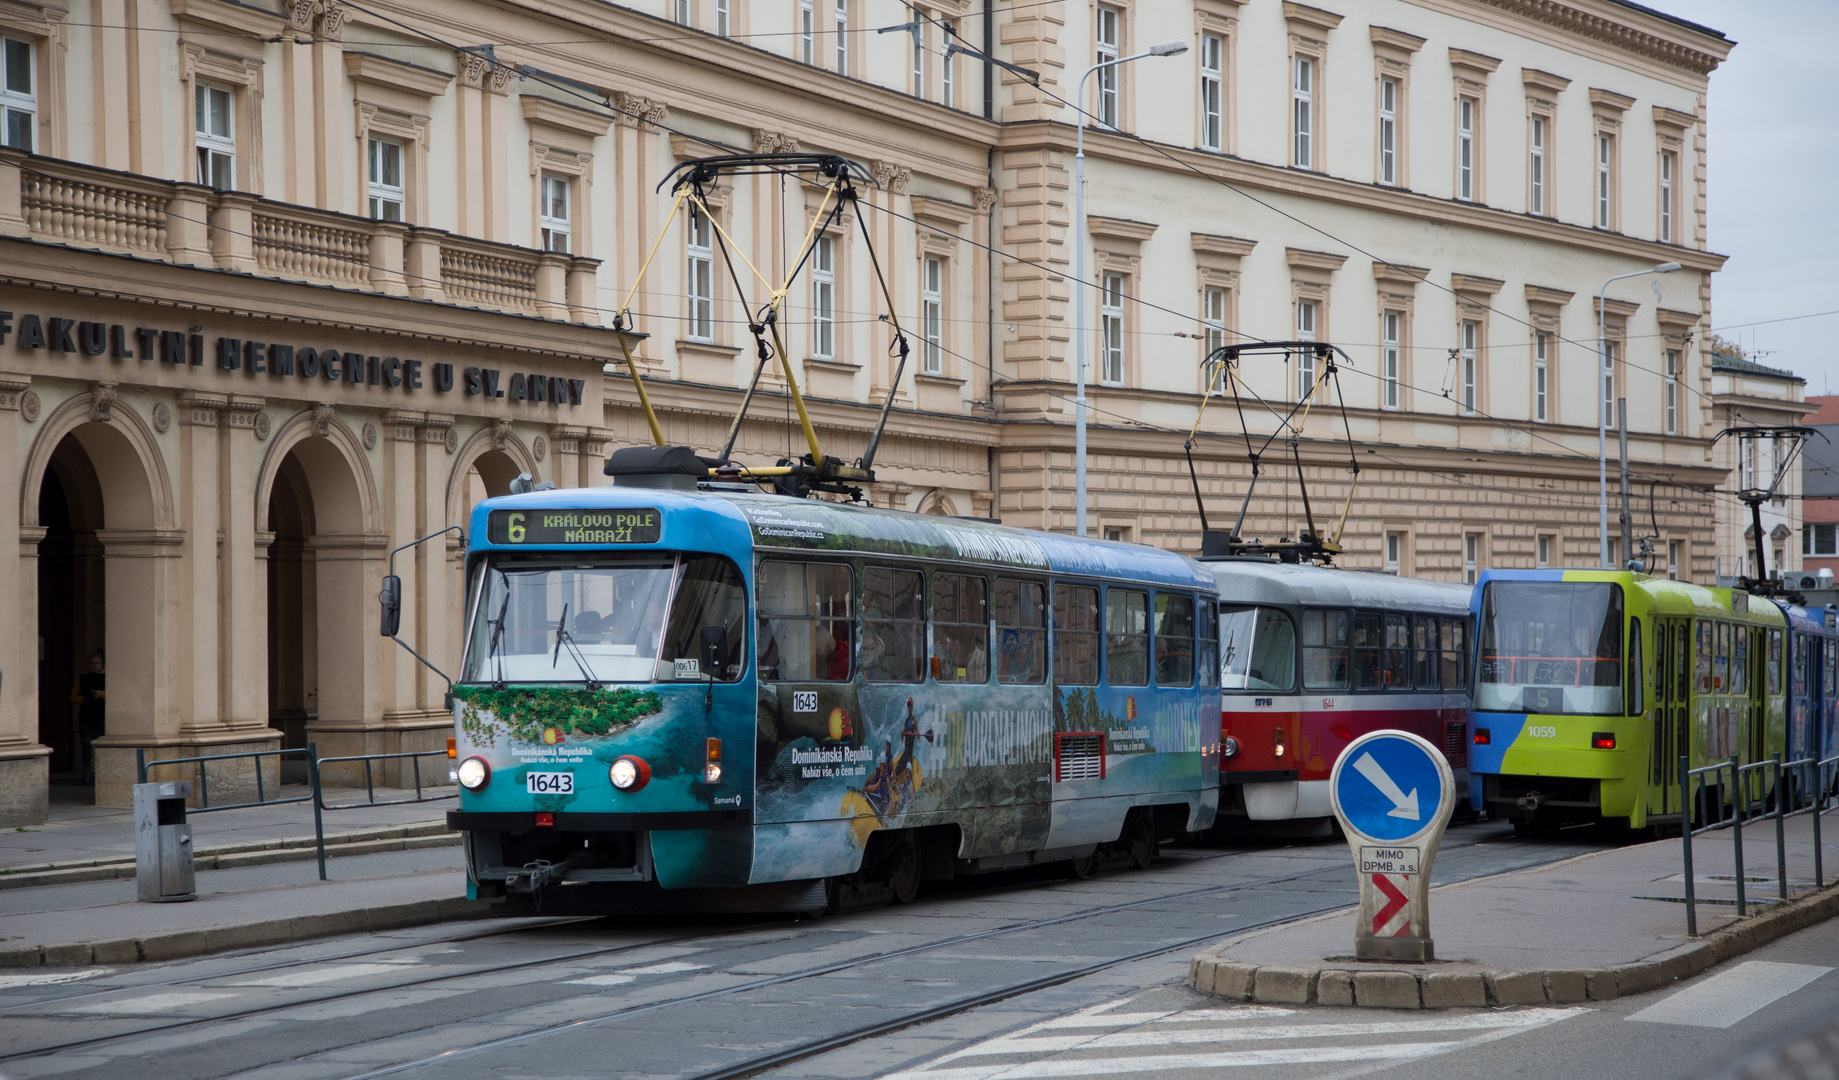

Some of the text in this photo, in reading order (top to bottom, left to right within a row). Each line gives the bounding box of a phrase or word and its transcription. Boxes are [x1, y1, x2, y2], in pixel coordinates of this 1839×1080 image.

[0, 311, 585, 406] FAKULTNÍ NEMOCNICE U SV. ANNY
[508, 513, 526, 543] 6
[543, 512, 654, 528] KRÁLOVO POLE
[564, 526, 633, 543] NÁDRAŽÍ
[794, 693, 817, 711] 1643
[1537, 689, 1549, 709] 5
[1527, 726, 1556, 738] 1059
[511, 746, 593, 757] Dominikánská Republika
[791, 745, 873, 765] Dominikánská Republika
[801, 764, 867, 779] Nabízí vše, o čem sníte
[528, 774, 573, 792] 1643
[1376, 849, 1404, 860] MIMO
[1399, 864, 1417, 873] a.s.
